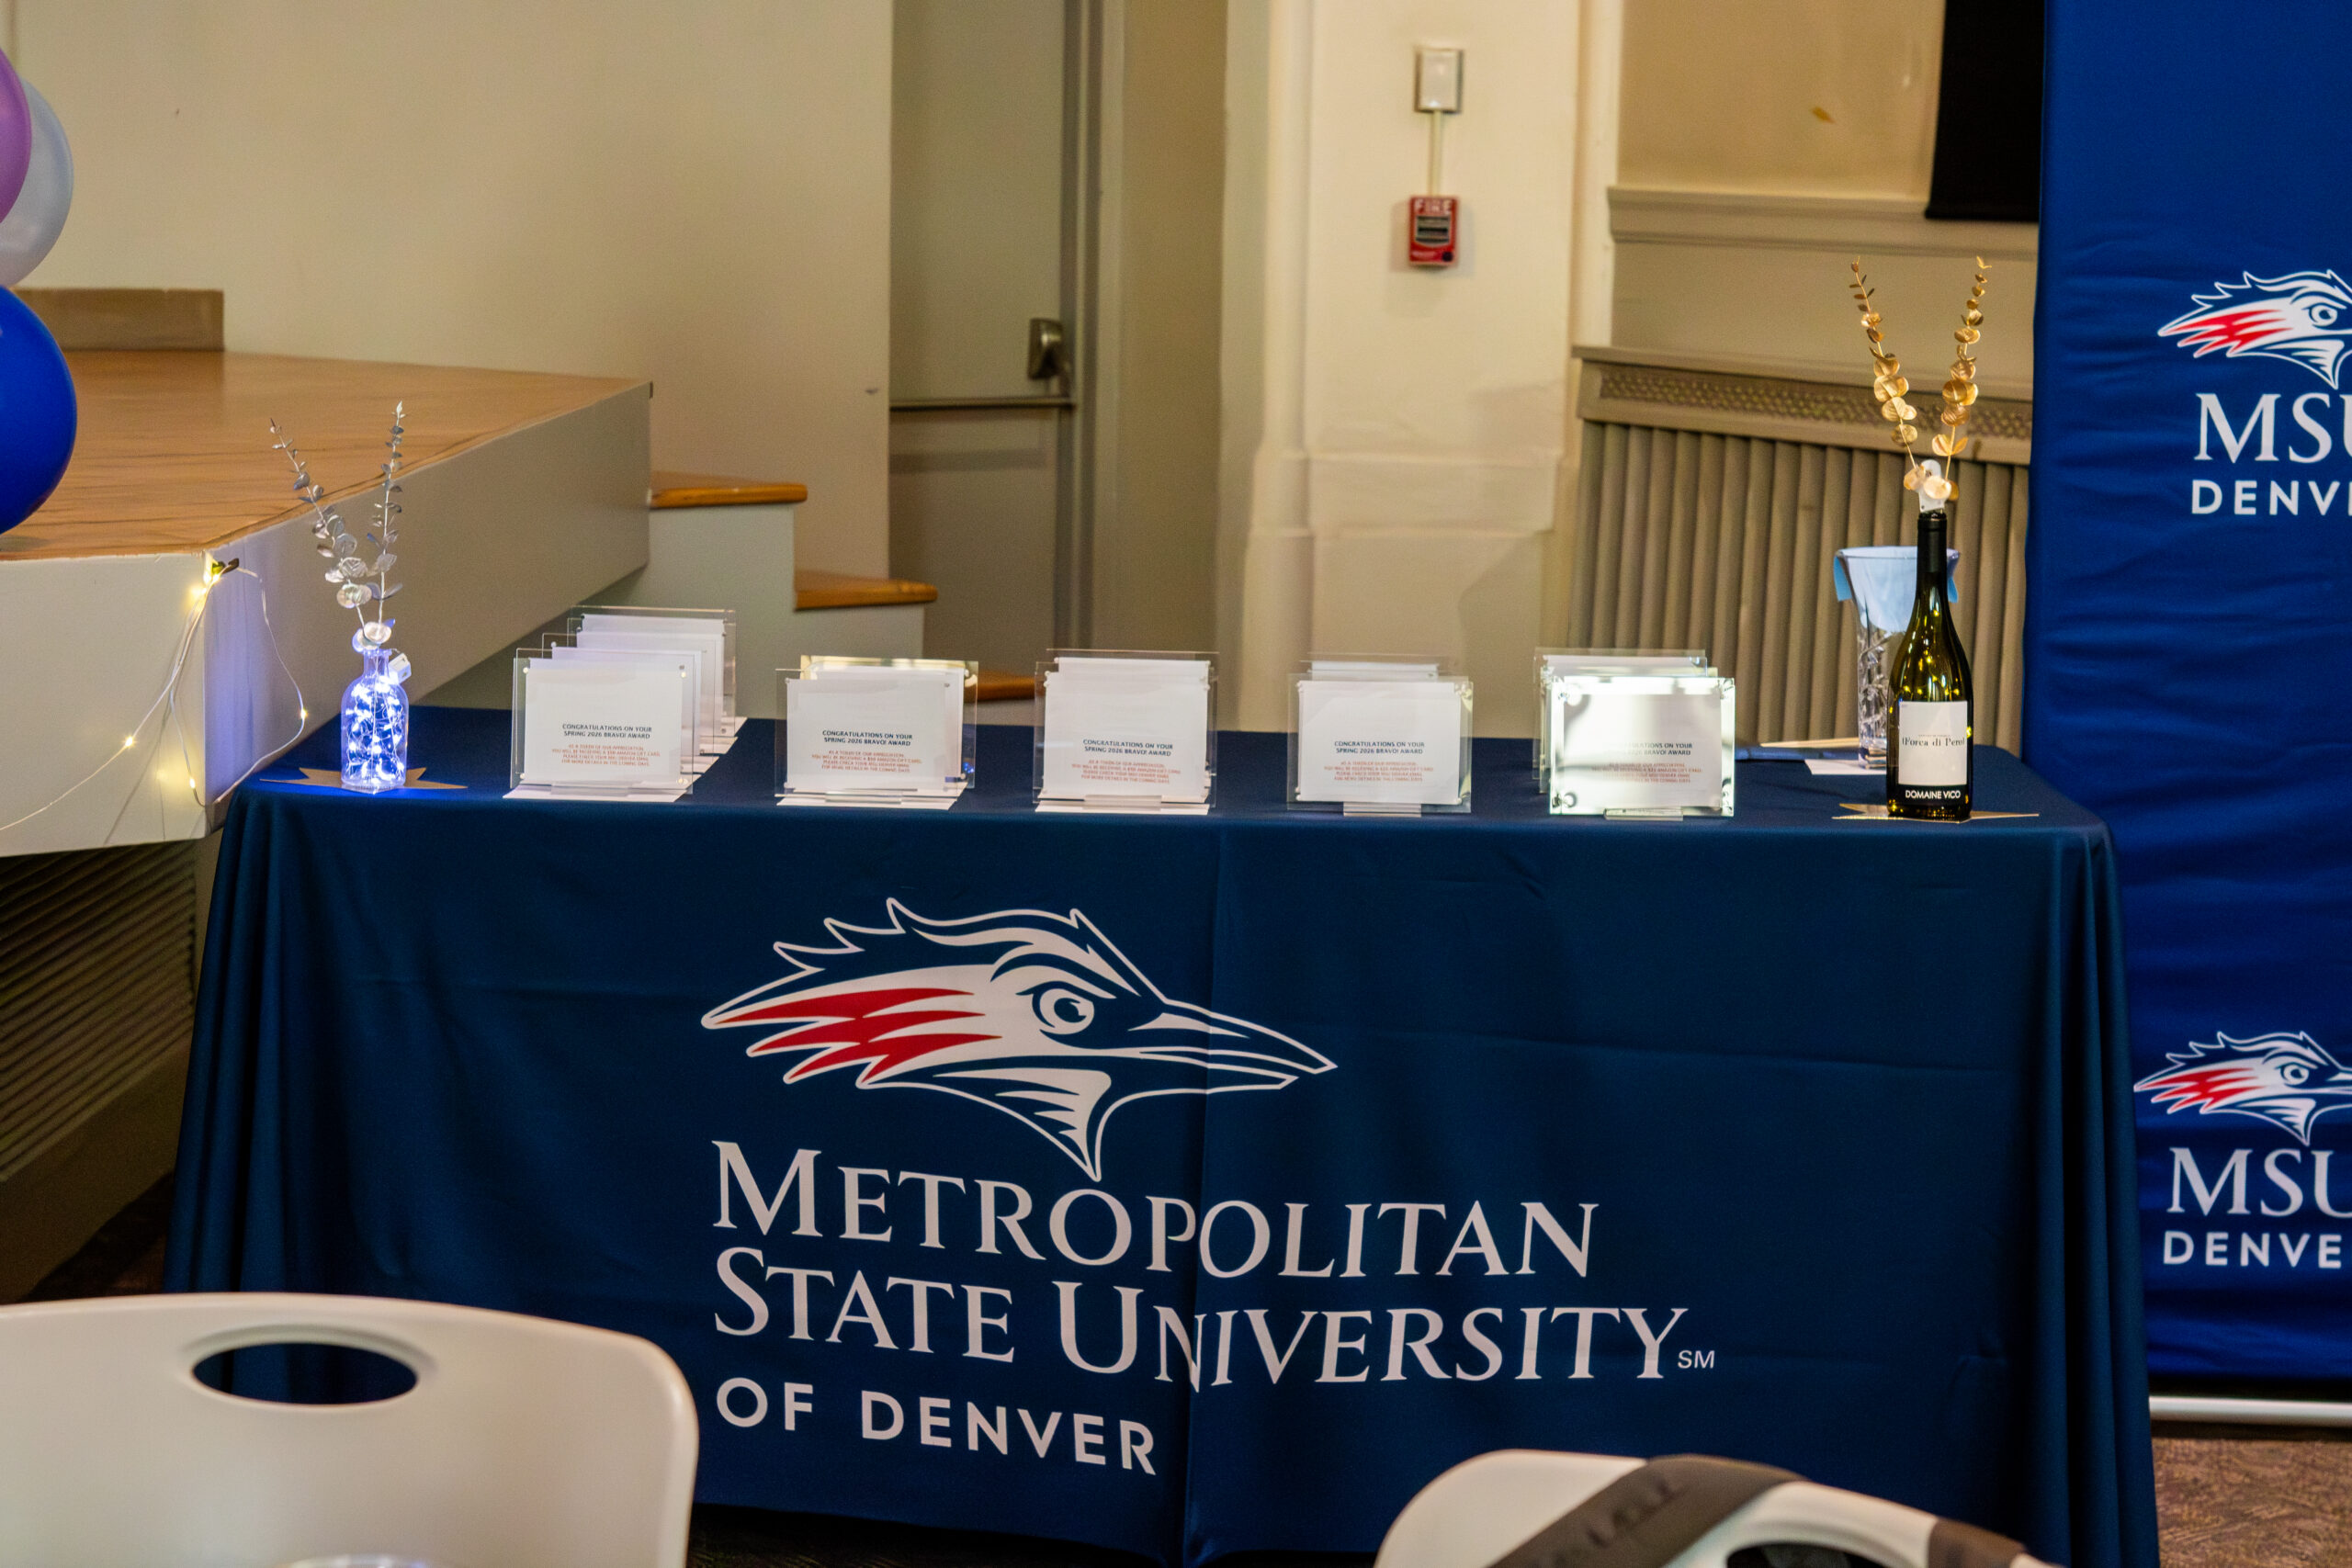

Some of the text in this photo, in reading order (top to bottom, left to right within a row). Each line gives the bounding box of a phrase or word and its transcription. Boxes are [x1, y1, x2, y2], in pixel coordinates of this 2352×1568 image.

[1414, 198, 1452, 215] FIRE
[2194, 391, 2352, 464] MS
[2191, 479, 2352, 516] DENV
[562, 723, 622, 732] CONGRATULATIONS
[822, 730, 883, 738] CONGRATULATIONS
[1083, 739, 1144, 748] CONGRATULATIONS
[1905, 790, 1961, 799] DOMAINE VICO
[711, 1140, 1600, 1279] METROPOLITAN
[714, 1247, 1715, 1393] STATE UNIVERSITY SM
[717, 1377, 1156, 1475] OF DENVER
